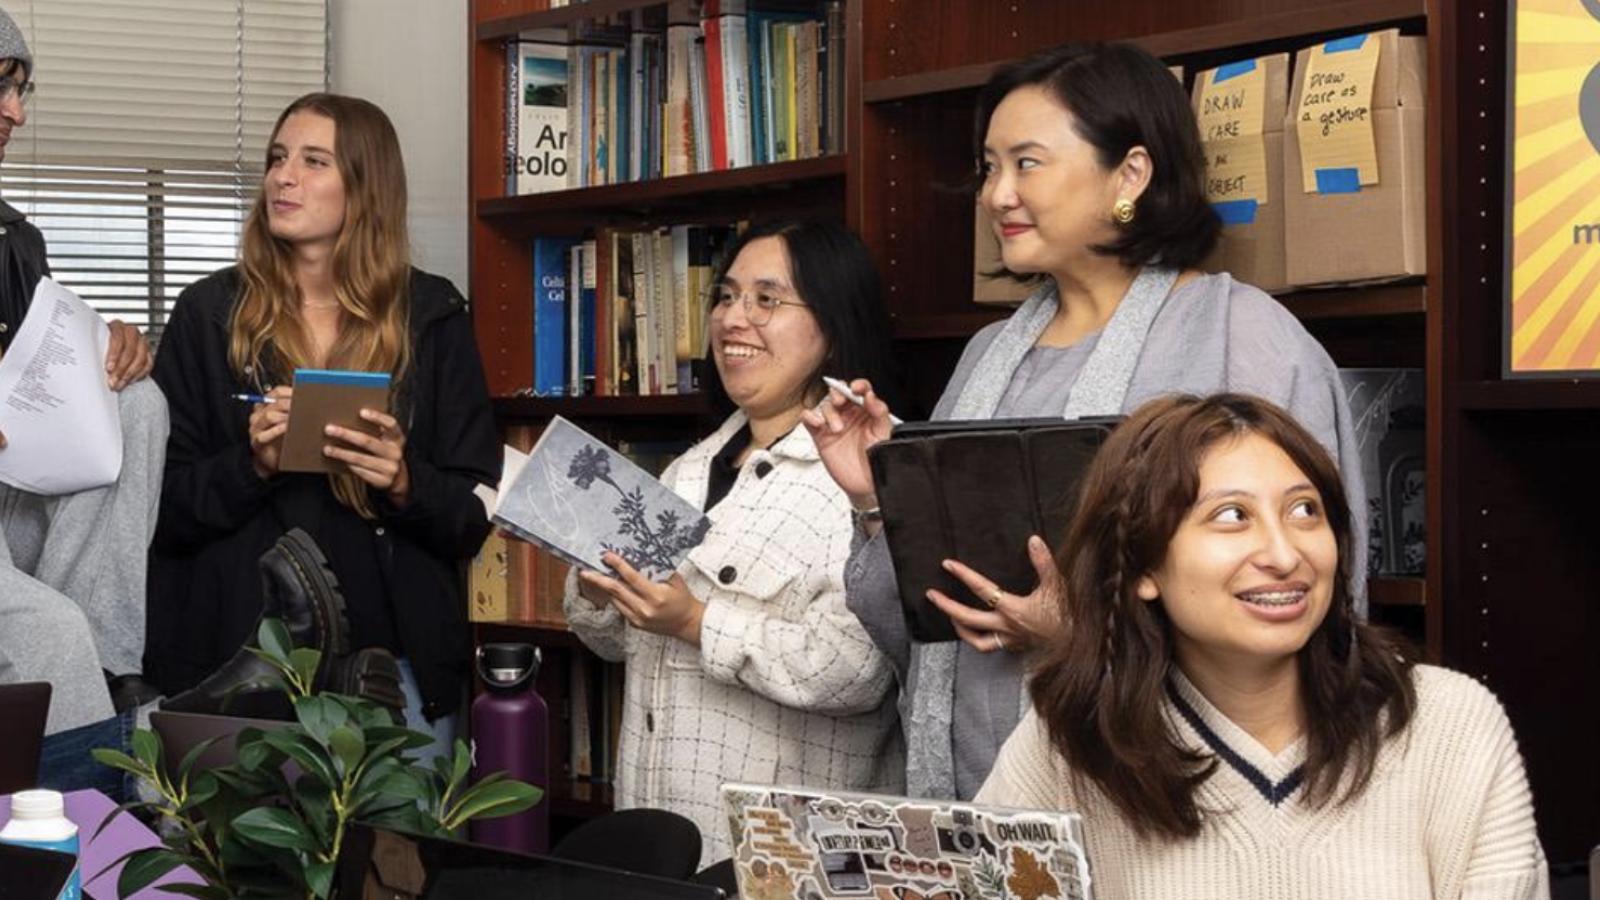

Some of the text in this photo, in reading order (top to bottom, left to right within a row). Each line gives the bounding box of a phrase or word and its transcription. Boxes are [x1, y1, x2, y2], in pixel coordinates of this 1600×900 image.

[1311, 73, 1345, 88] Draw
[1204, 89, 1245, 115] DRAW
[1304, 85, 1357, 106] care as
[1208, 120, 1240, 140] CARE
[1302, 106, 1368, 136] a gesture
[997, 824, 1018, 842] OH
